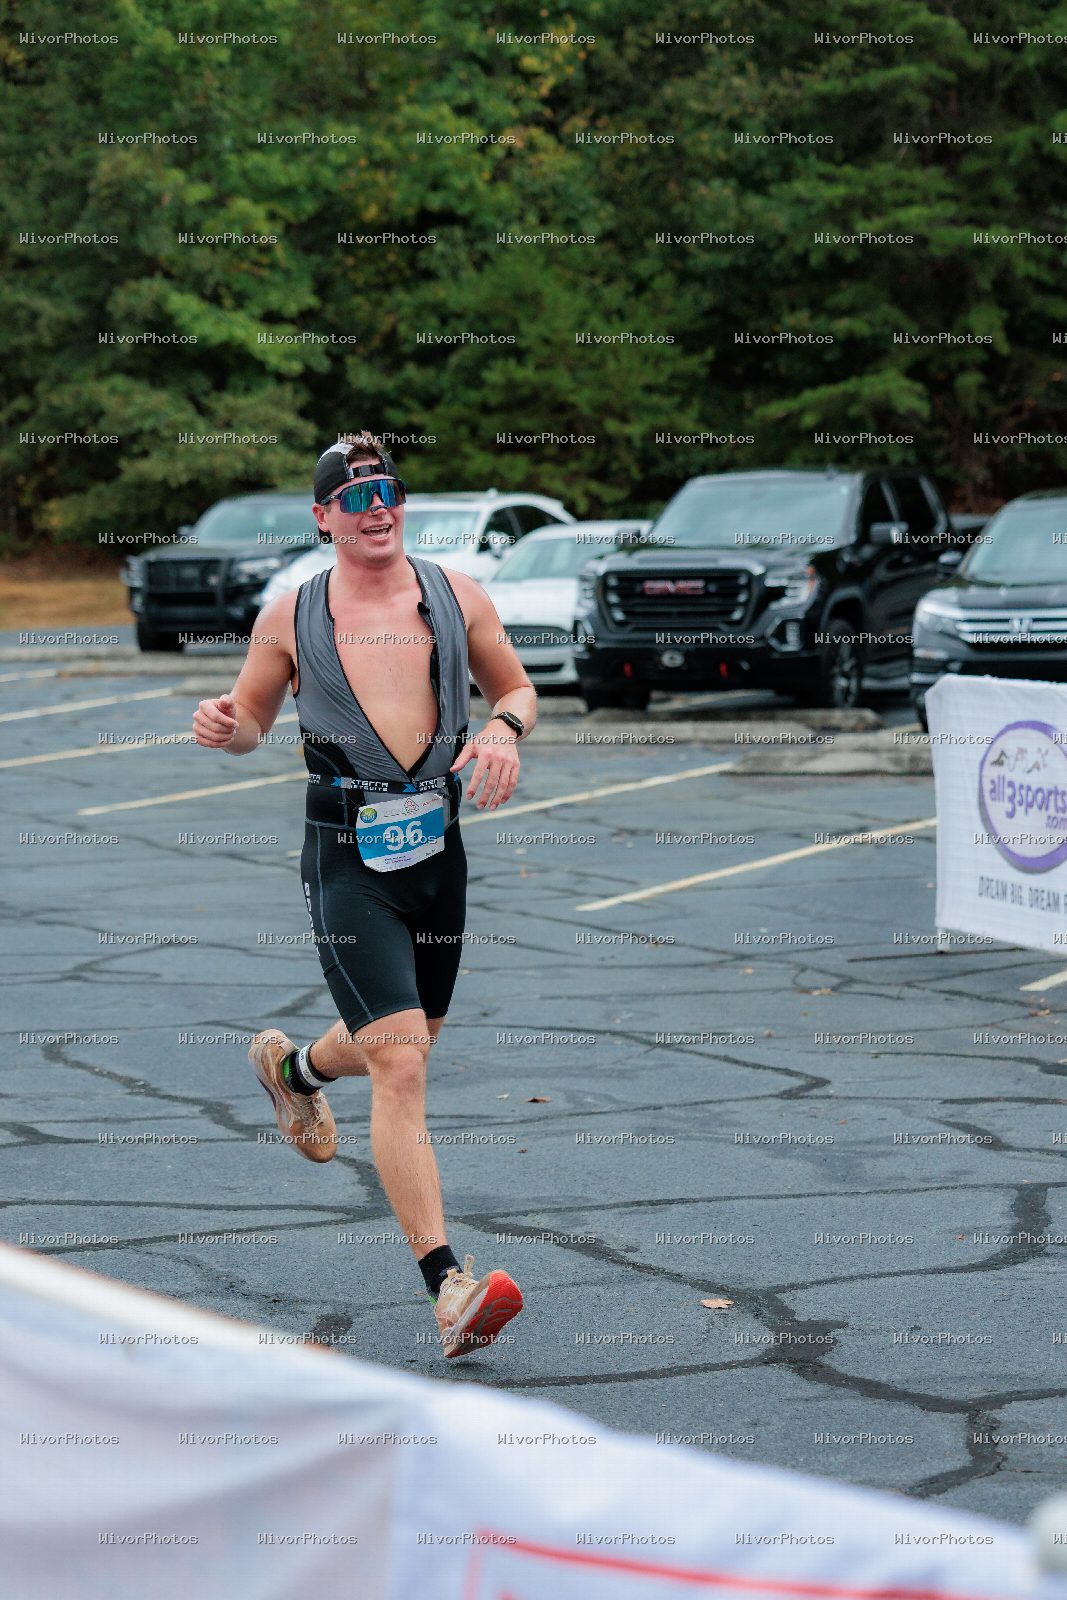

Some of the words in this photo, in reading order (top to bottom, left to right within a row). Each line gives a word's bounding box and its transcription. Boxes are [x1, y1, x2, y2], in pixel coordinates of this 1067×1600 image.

[988, 774, 1067, 819] all3sports
[384, 820, 423, 851] 96
[978, 875, 1008, 904] DREAM
[1028, 886, 1060, 913] DREAM
